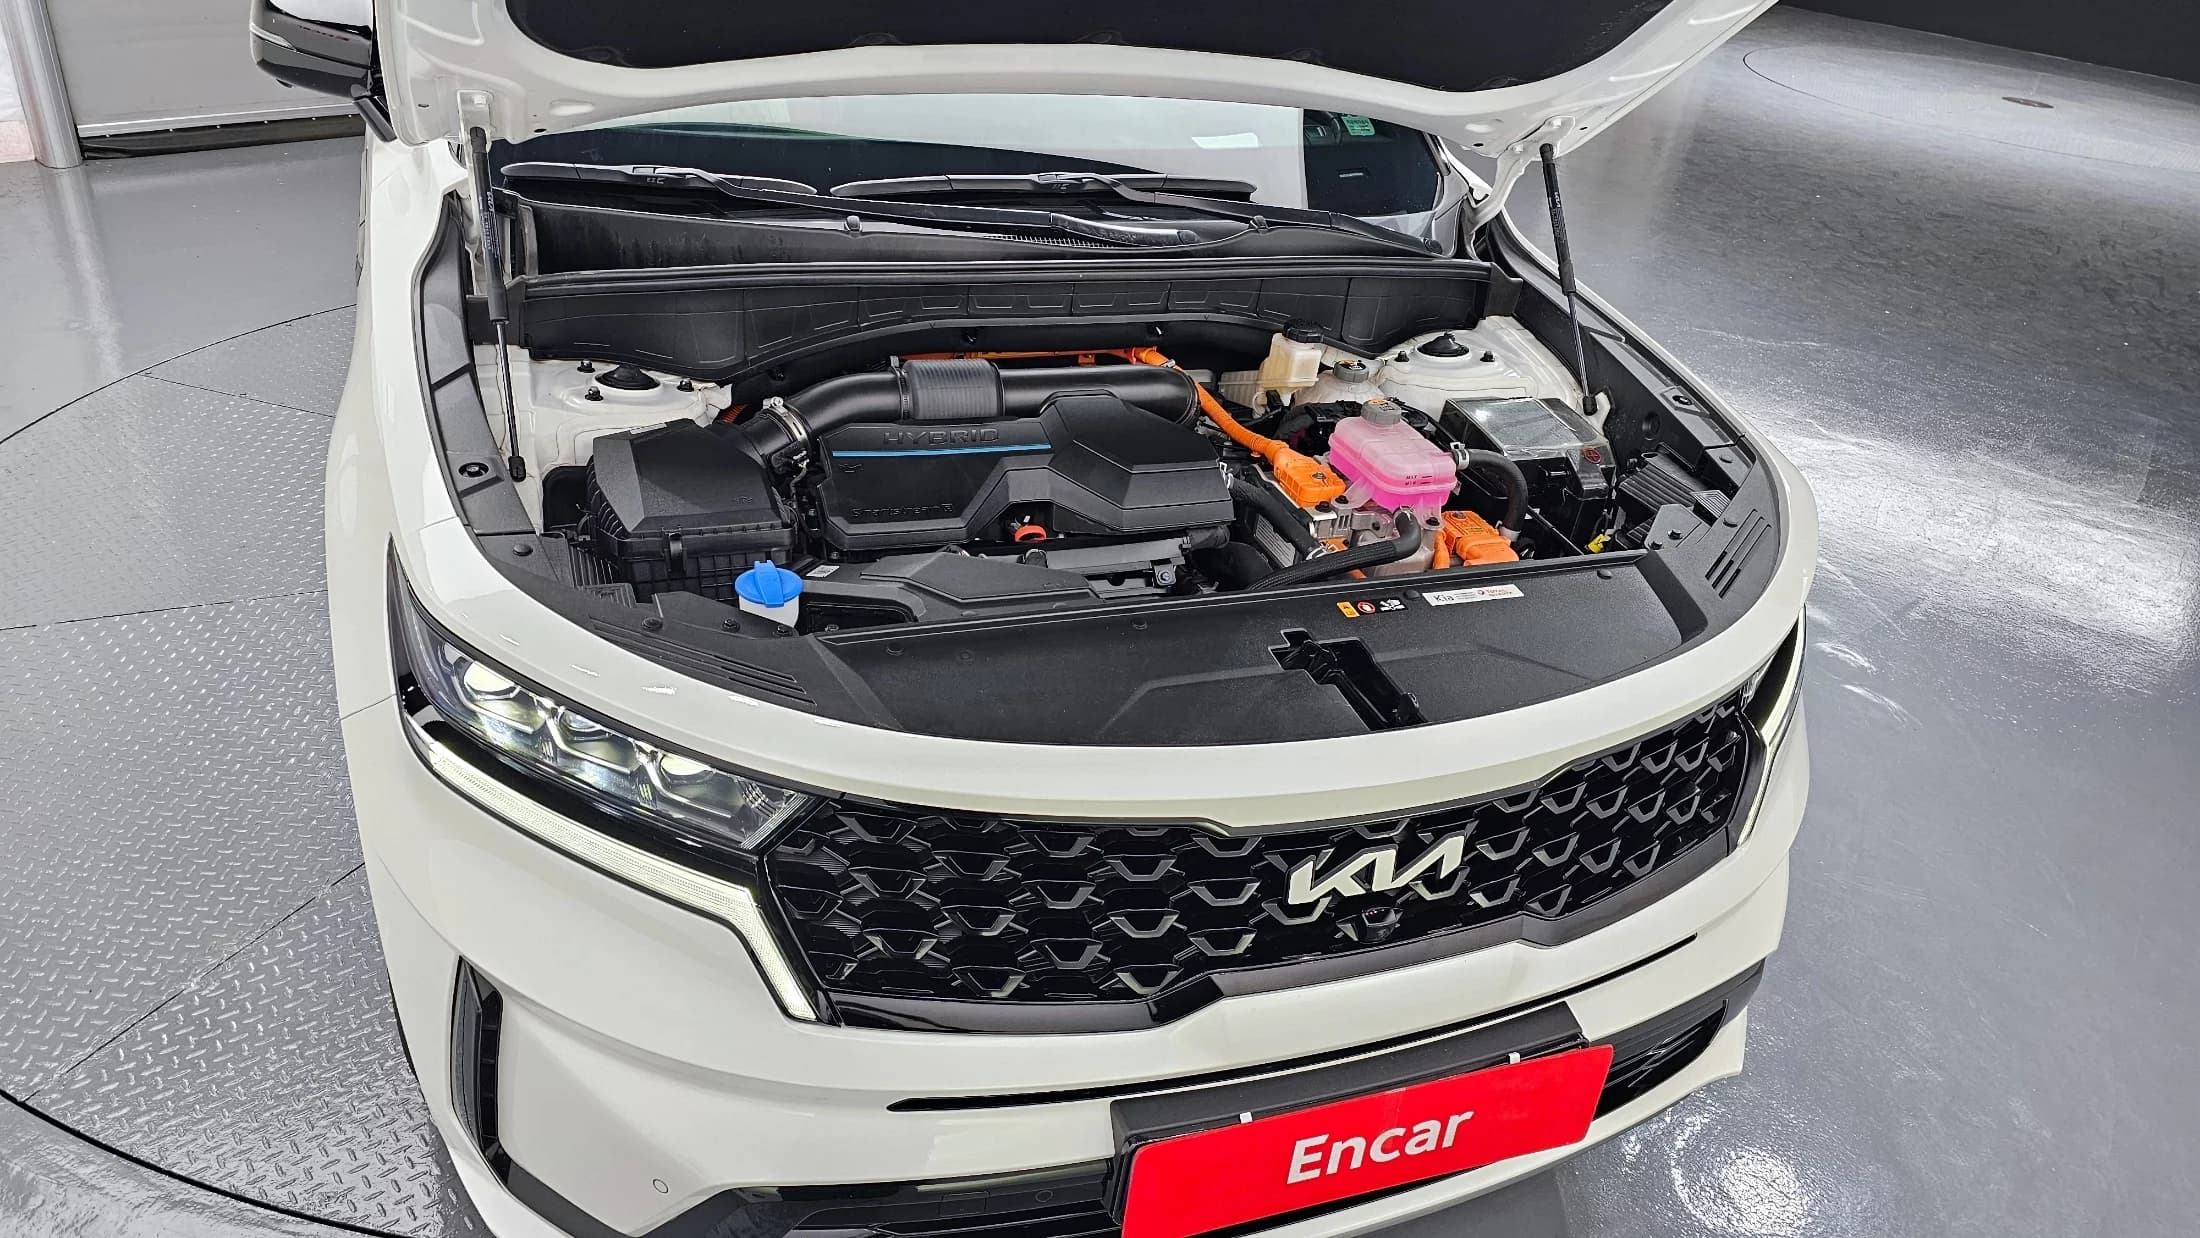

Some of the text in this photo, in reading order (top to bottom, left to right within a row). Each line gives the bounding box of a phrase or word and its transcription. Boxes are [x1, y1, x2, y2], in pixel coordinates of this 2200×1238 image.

[883, 428, 999, 446] HYBRID
[1287, 834, 1465, 905] KIA
[1287, 1111, 1474, 1185] Encar
